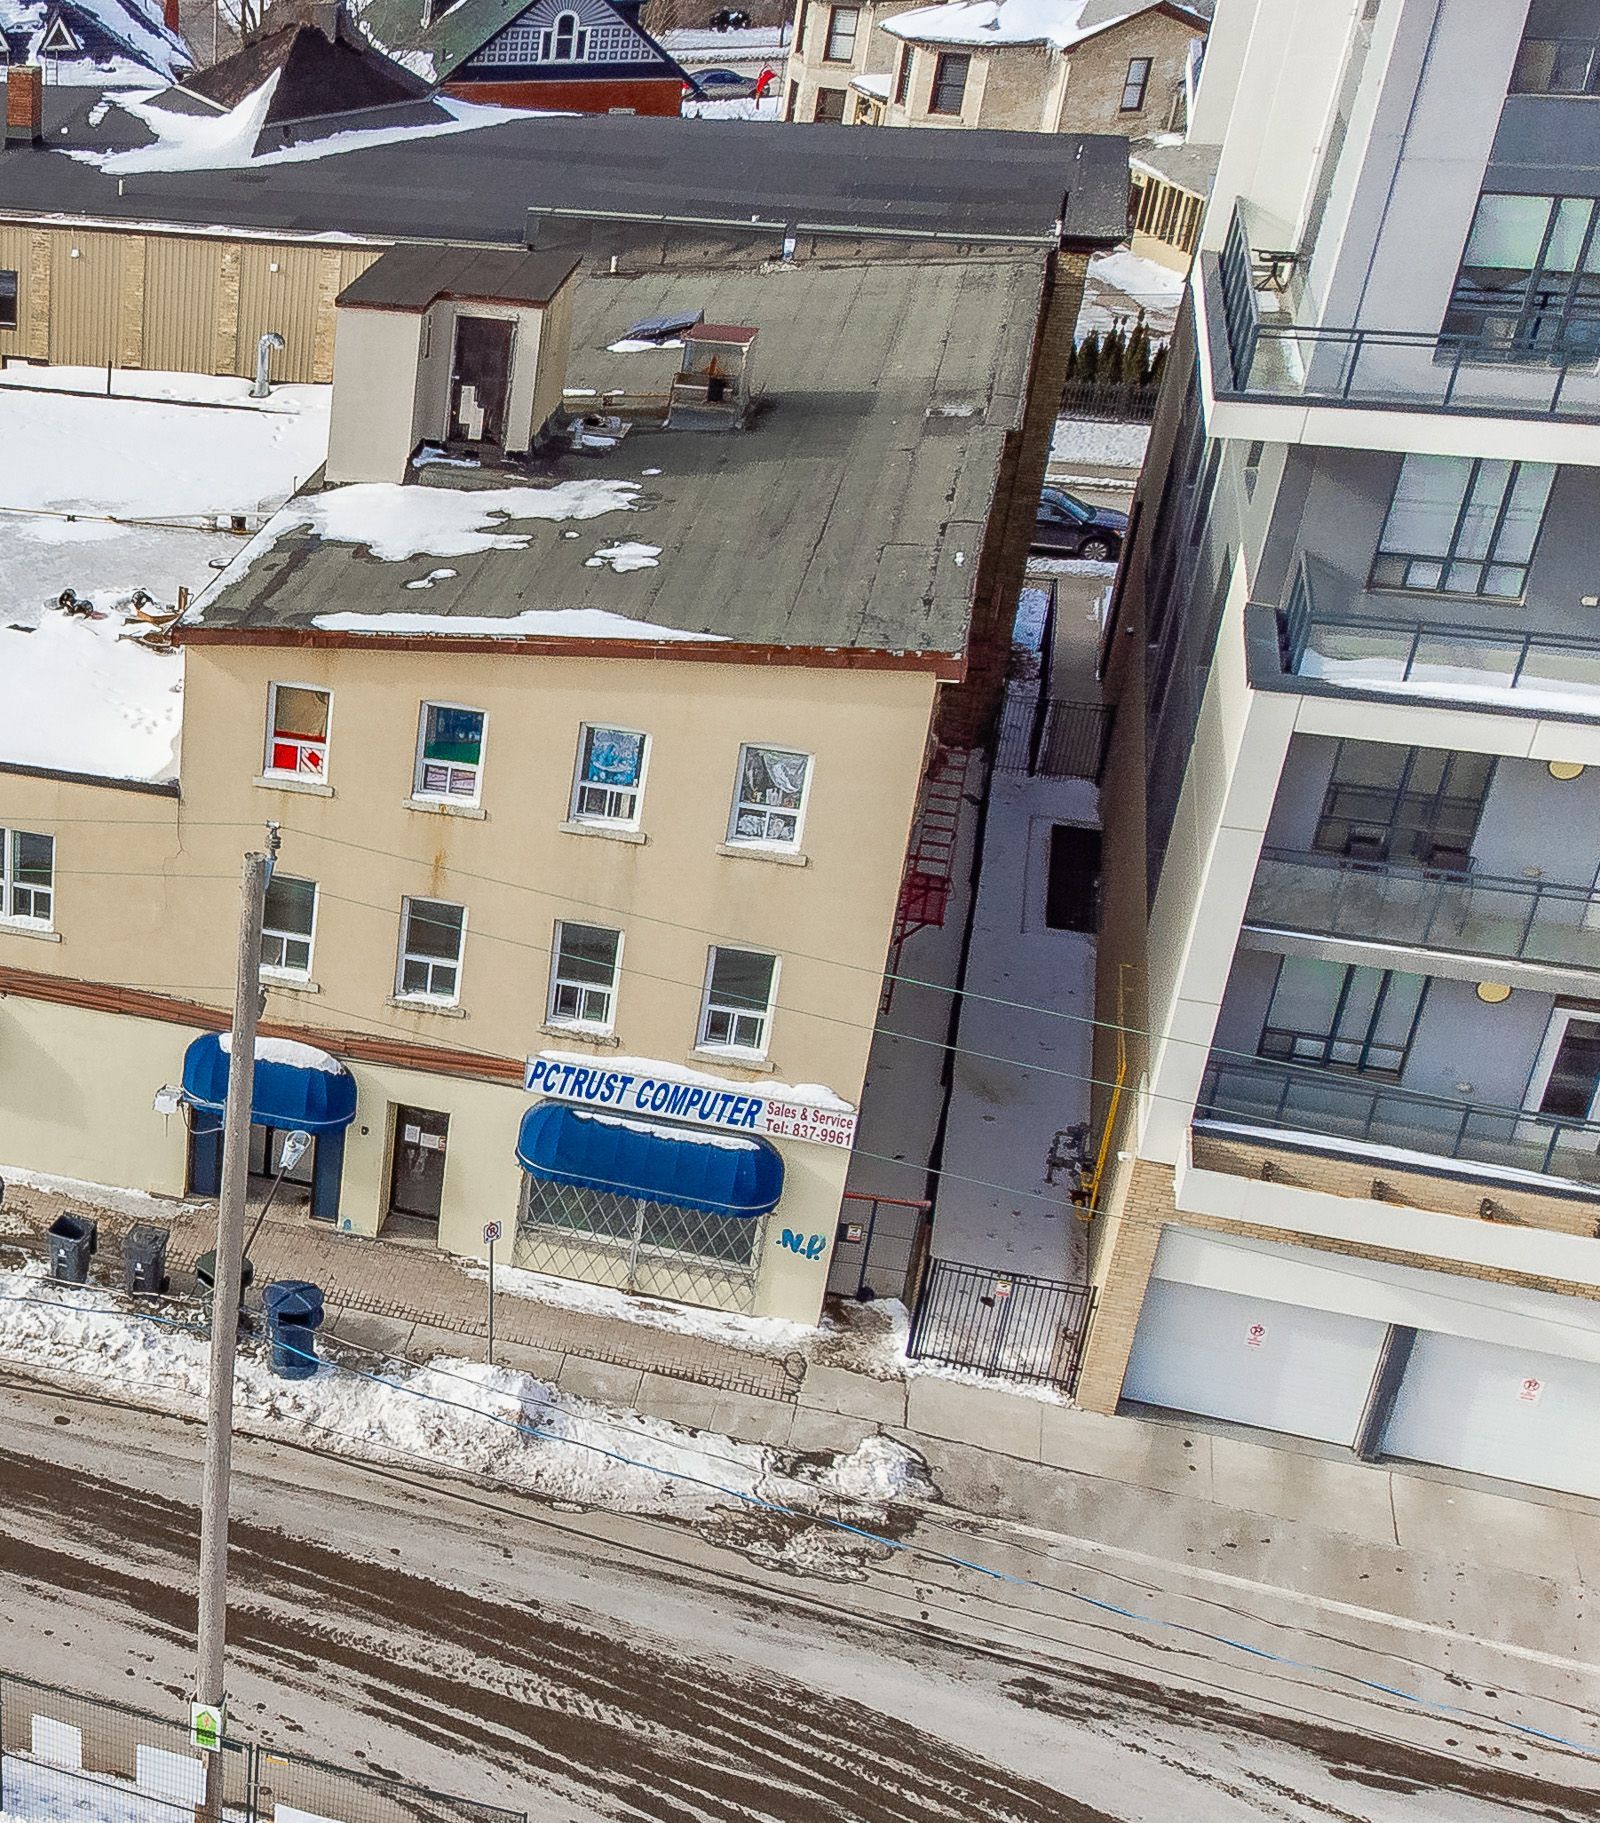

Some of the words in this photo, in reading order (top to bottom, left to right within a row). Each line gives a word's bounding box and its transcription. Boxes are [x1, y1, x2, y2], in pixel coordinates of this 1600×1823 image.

[527, 1061, 634, 1104] PCTRUST
[636, 1080, 763, 1128] COMPUTER
[767, 1102, 797, 1119] Sales
[800, 1107, 808, 1121] &
[811, 1110, 853, 1129] Service
[766, 1119, 789, 1134] Tel:
[791, 1123, 852, 1146] 837-9961
